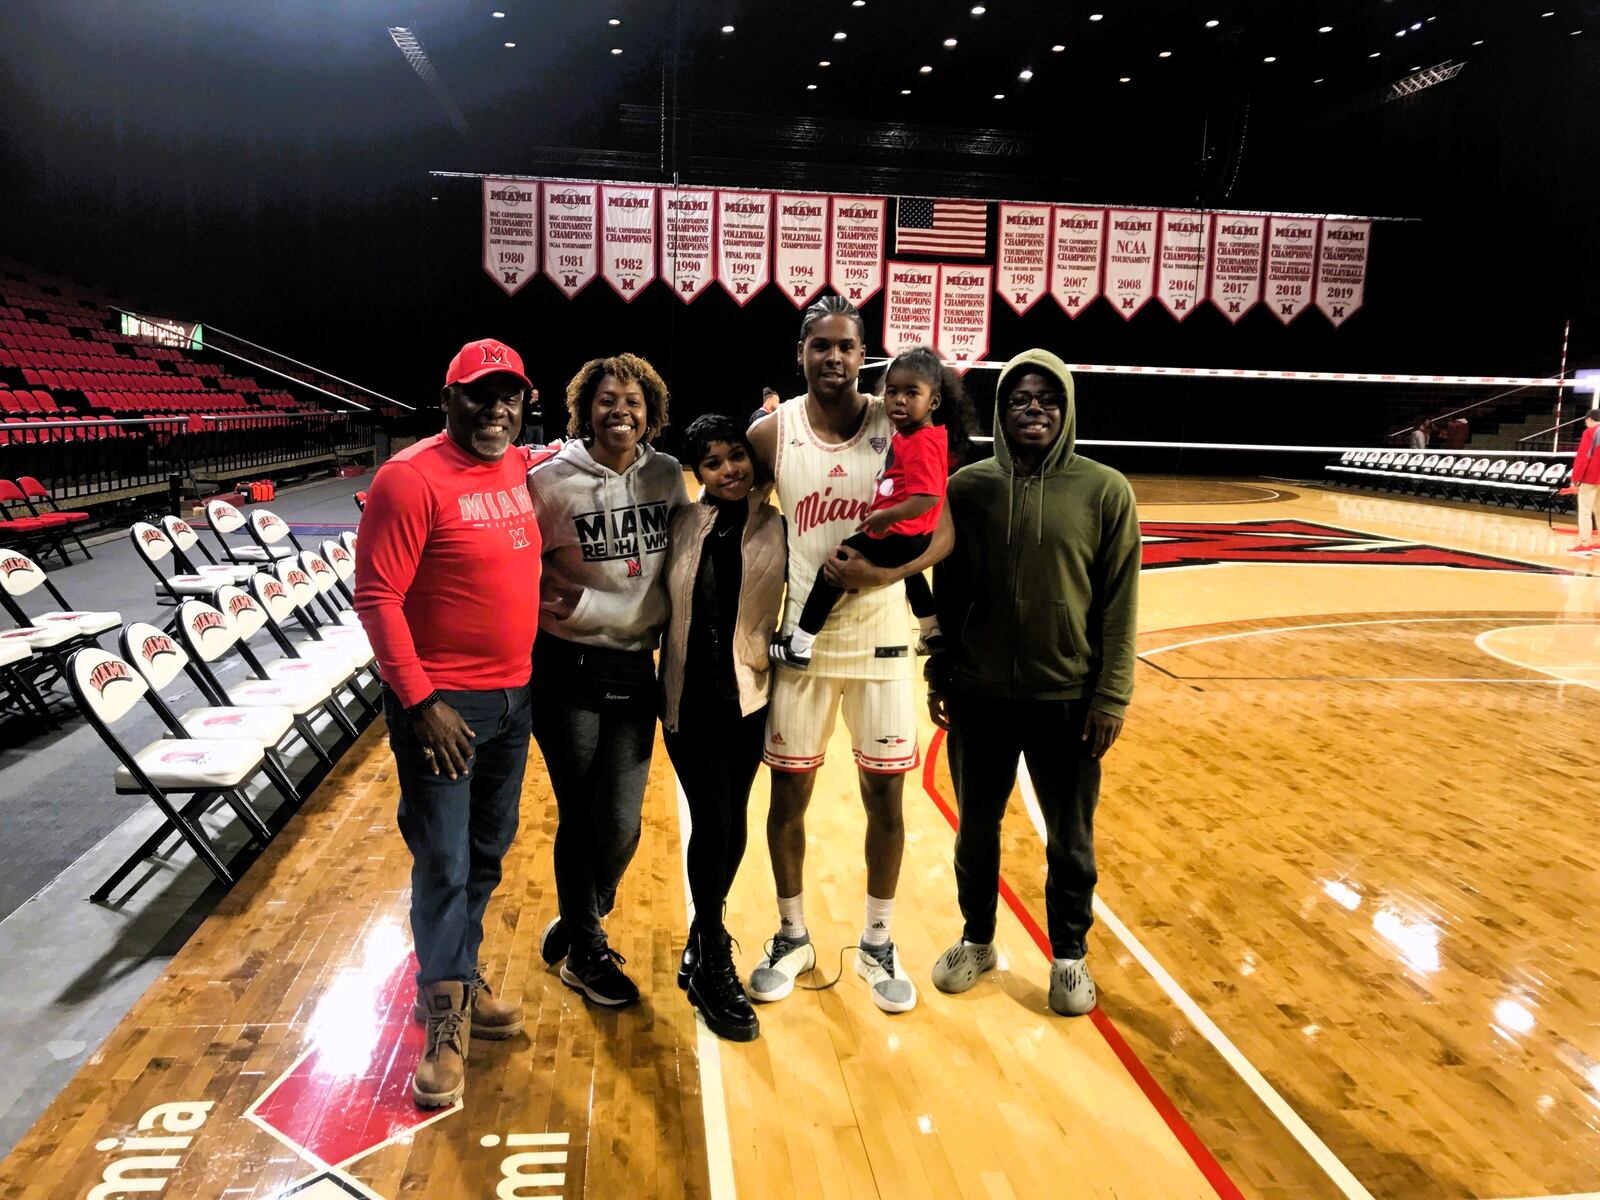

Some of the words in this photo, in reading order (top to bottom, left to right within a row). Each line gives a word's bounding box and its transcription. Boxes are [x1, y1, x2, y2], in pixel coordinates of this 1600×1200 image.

[490, 190, 532, 202] MIAMI
[550, 194, 591, 205] MIAMI
[608, 197, 650, 208] MIAMI
[668, 200, 708, 210] MIAMI
[725, 202, 765, 214] MIAMI
[782, 206, 822, 216] MIAMI
[838, 208, 878, 218] MIAMI
[490, 218, 532, 227] TOURNAMENT
[549, 222, 592, 230] TOURNAMENT
[1006, 216, 1045, 226] MIAMI
[1060, 218, 1098, 229] MIAMI
[1114, 221, 1152, 231] MIAMI
[490, 227, 532, 236] CHAMPIONS
[667, 224, 708, 232] CHAMPIONS
[1168, 222, 1204, 232] MIAMI
[1222, 226, 1258, 236] MIAMI
[550, 230, 592, 240] CHAMPIONS
[724, 230, 765, 239] VOLLEYBALL
[782, 233, 822, 242] VOLLEYBALL
[837, 232, 878, 240] CHAMPIONS
[1275, 228, 1312, 238] MIAMI
[1327, 230, 1365, 240] MIAMI
[606, 234, 652, 244] CHAMPIONS
[1004, 238, 1044, 247] CHAMPIONS
[667, 242, 708, 250] CHAMPIONS
[836, 242, 878, 250] TOURNAMENT
[1058, 245, 1097, 253] TOURNAMENT
[1117, 240, 1146, 254] NCAA
[726, 251, 743, 259] FINAL
[836, 250, 878, 258] CHAMPIONS
[1164, 252, 1205, 262] CHAMPIONS
[1218, 248, 1259, 256] CHAMPIONS
[1271, 250, 1312, 258] CHAMPIONS
[1323, 252, 1364, 262] CHAMPIONS
[498, 252, 524, 264] 1980
[558, 255, 583, 266] 1981
[1004, 256, 1044, 264] CHAMPIONS
[1058, 253, 1096, 262] CHAMPIONS
[1217, 257, 1258, 266] TOURNAMENT
[614, 258, 642, 270] 1982
[676, 261, 700, 272] 1990
[732, 264, 755, 274] 1991
[790, 266, 814, 276] 1994
[844, 268, 868, 279] 1995
[1216, 265, 1258, 274] CHAMPIONS
[1270, 266, 1310, 274] VOLLEYBALL
[1322, 268, 1362, 276] VOLLEYBALL
[504, 272, 518, 284] M
[564, 275, 577, 287] M
[894, 274, 932, 284] MIAMI
[946, 276, 984, 286] MIAMI
[1011, 274, 1034, 284] 1998
[1064, 277, 1088, 288] 2007
[622, 279, 635, 290] M
[681, 280, 694, 292] M
[736, 282, 749, 294] M
[1118, 279, 1141, 289] 2008
[1169, 280, 1195, 291] 2016
[1222, 282, 1249, 294] 2017
[794, 285, 807, 296] M
[849, 288, 862, 299] M
[1276, 285, 1302, 296] 2018
[1327, 287, 1353, 298] 2019
[892, 296, 932, 306] CHAMPIONS
[944, 299, 984, 308] CHAMPIONS
[1016, 293, 1028, 304] M
[1068, 296, 1080, 307] M
[1122, 298, 1135, 308] M
[1175, 299, 1187, 310] M
[1228, 302, 1241, 312] M
[1281, 304, 1294, 314] M
[891, 306, 931, 314] TOURNAMENT
[944, 309, 984, 317] TOURNAMENT
[1332, 306, 1344, 317] M
[890, 314, 930, 323] CHAMPIONS
[944, 316, 984, 325] CHAMPIONS
[898, 332, 922, 343] 1996
[951, 334, 976, 345] 1997
[480, 344, 512, 368] M
[458, 485, 534, 520] MIAM
[192, 612, 226, 636] MIAMI
[142, 636, 175, 662] MIAMI
[90, 661, 132, 692] MIAMI
